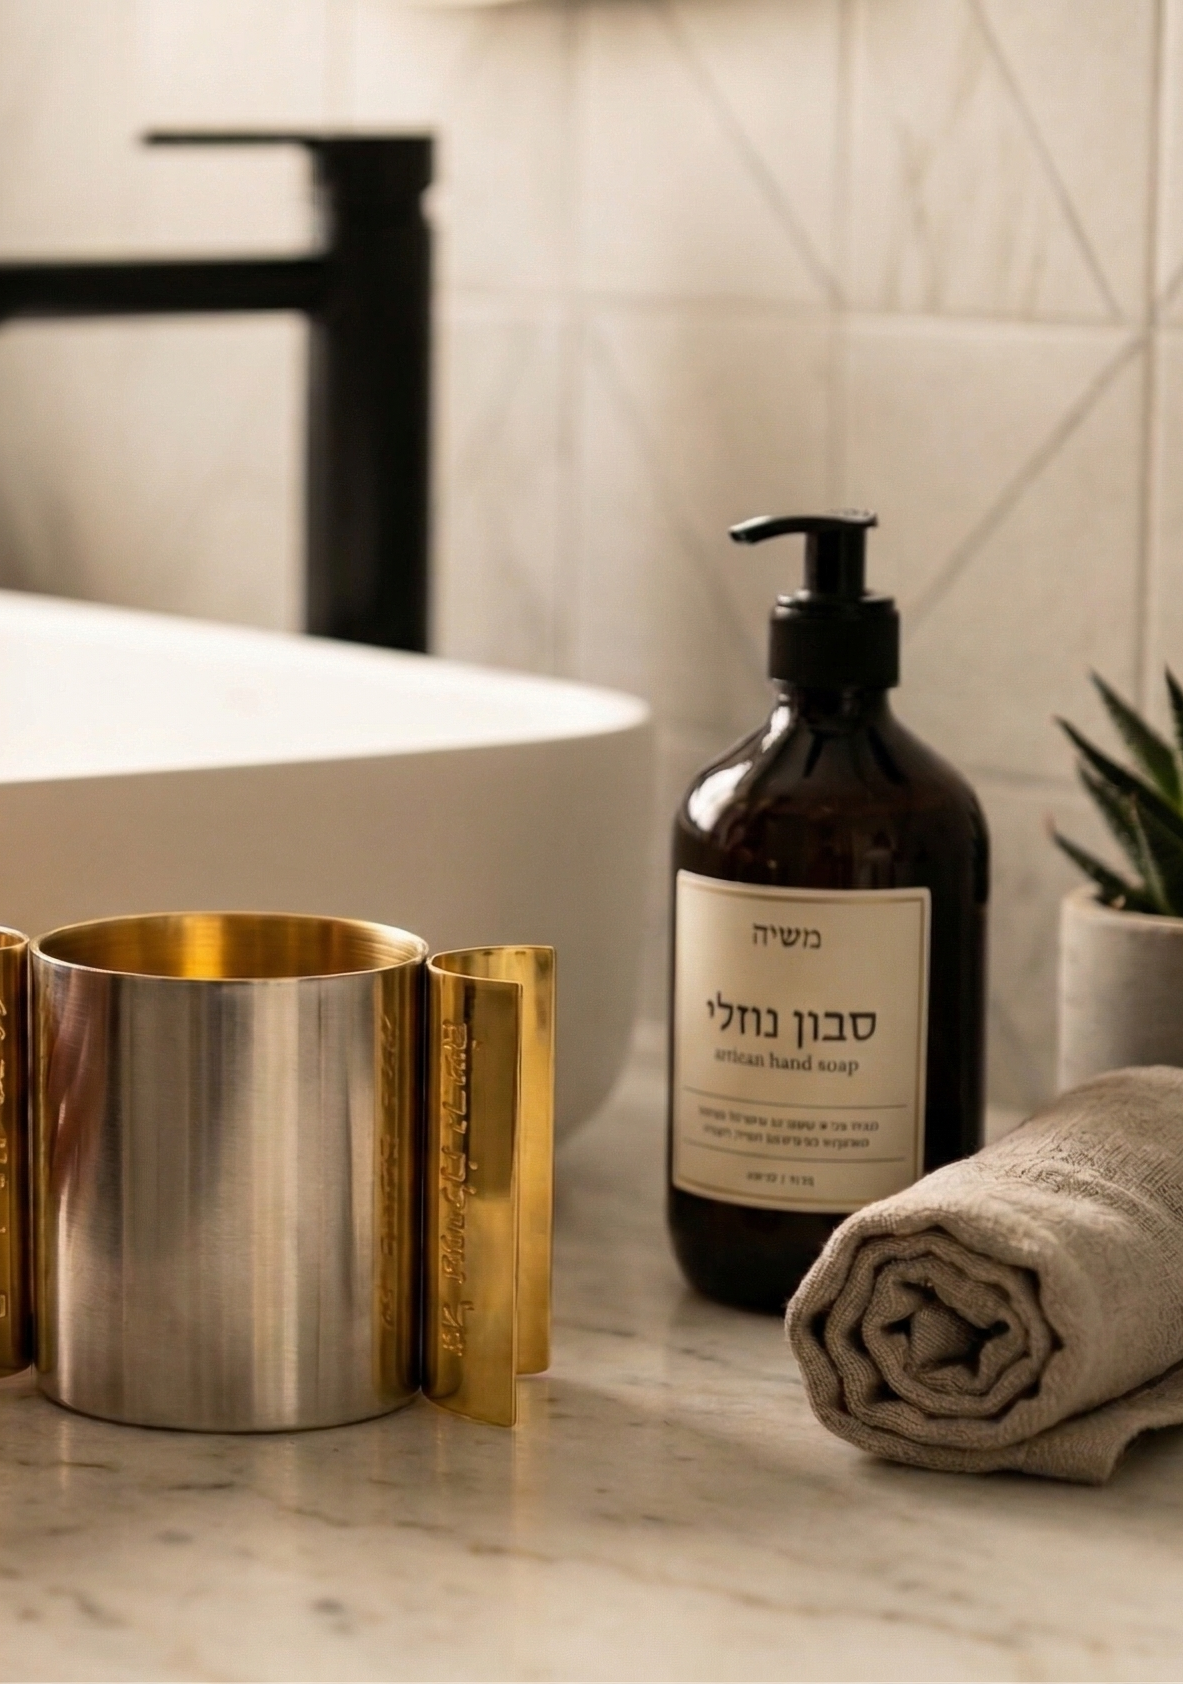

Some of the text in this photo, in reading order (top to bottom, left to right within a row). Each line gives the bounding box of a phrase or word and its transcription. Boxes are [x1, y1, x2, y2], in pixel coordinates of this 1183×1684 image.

[706, 990, 877, 1049] סבון נוזלי
[769, 1053, 813, 1072] hand
[818, 1059, 859, 1077] soap
